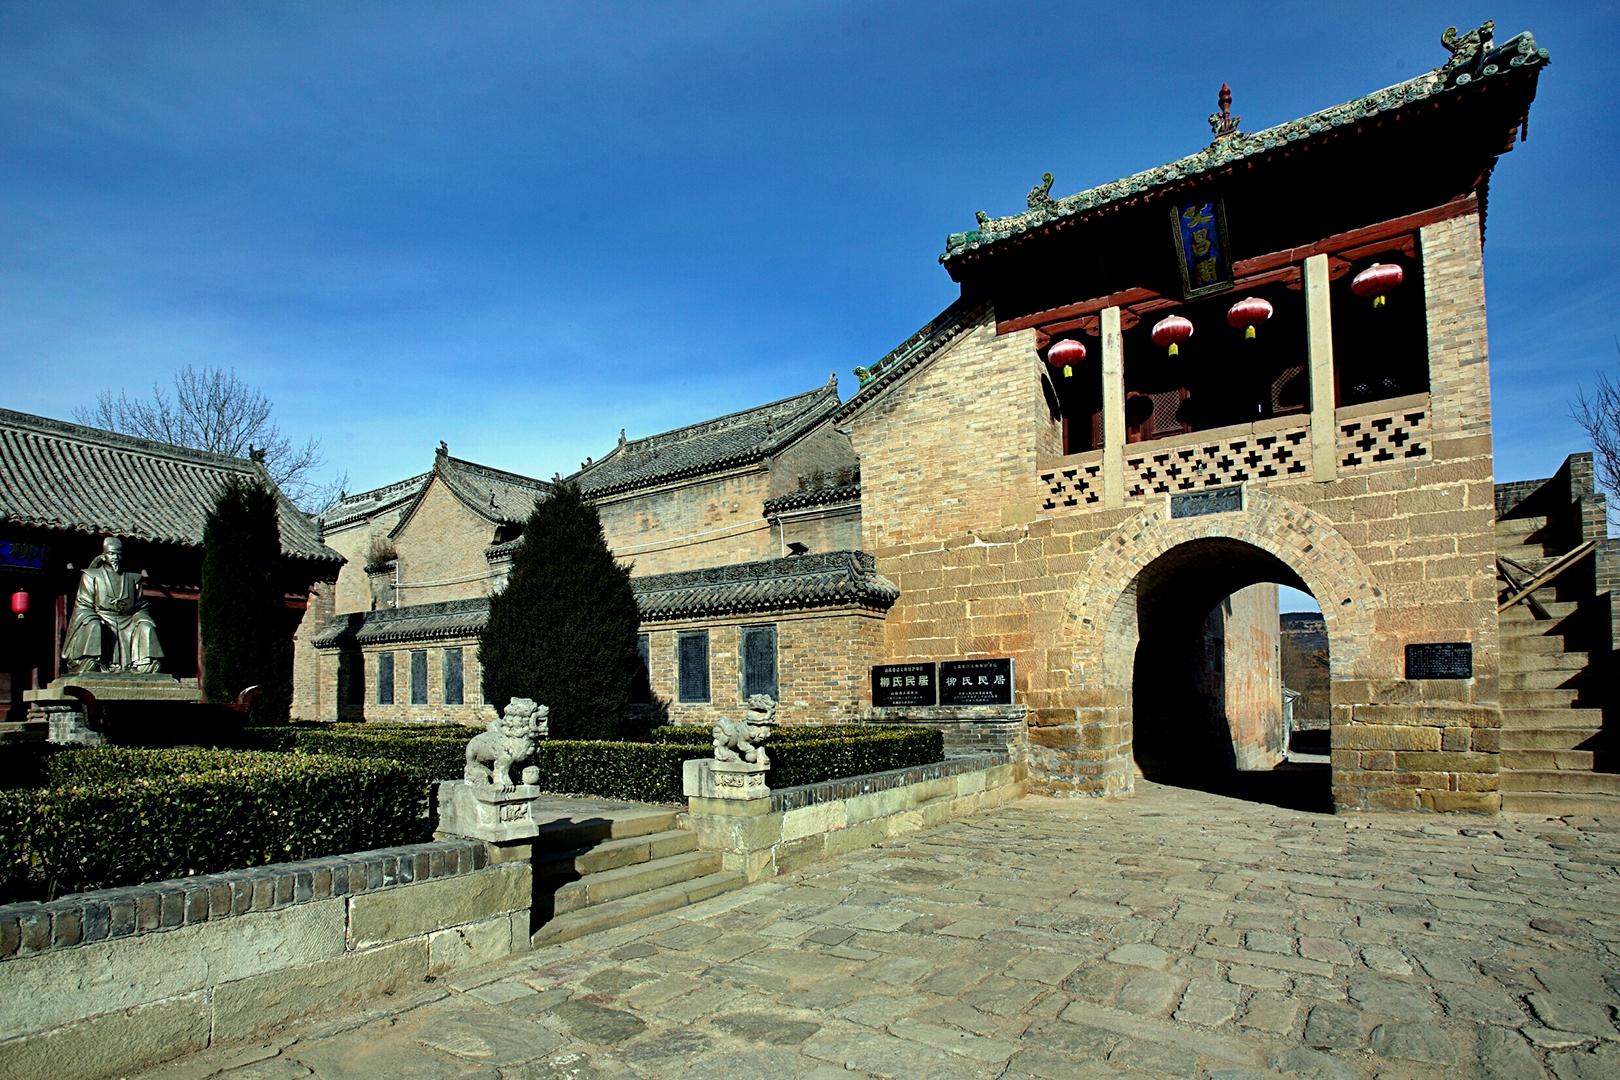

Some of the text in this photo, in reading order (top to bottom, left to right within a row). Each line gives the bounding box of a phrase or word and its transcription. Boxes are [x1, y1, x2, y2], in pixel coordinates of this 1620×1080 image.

[880, 675, 928, 687] 柳氏民居
[946, 675, 1006, 686] 柳氏民居
